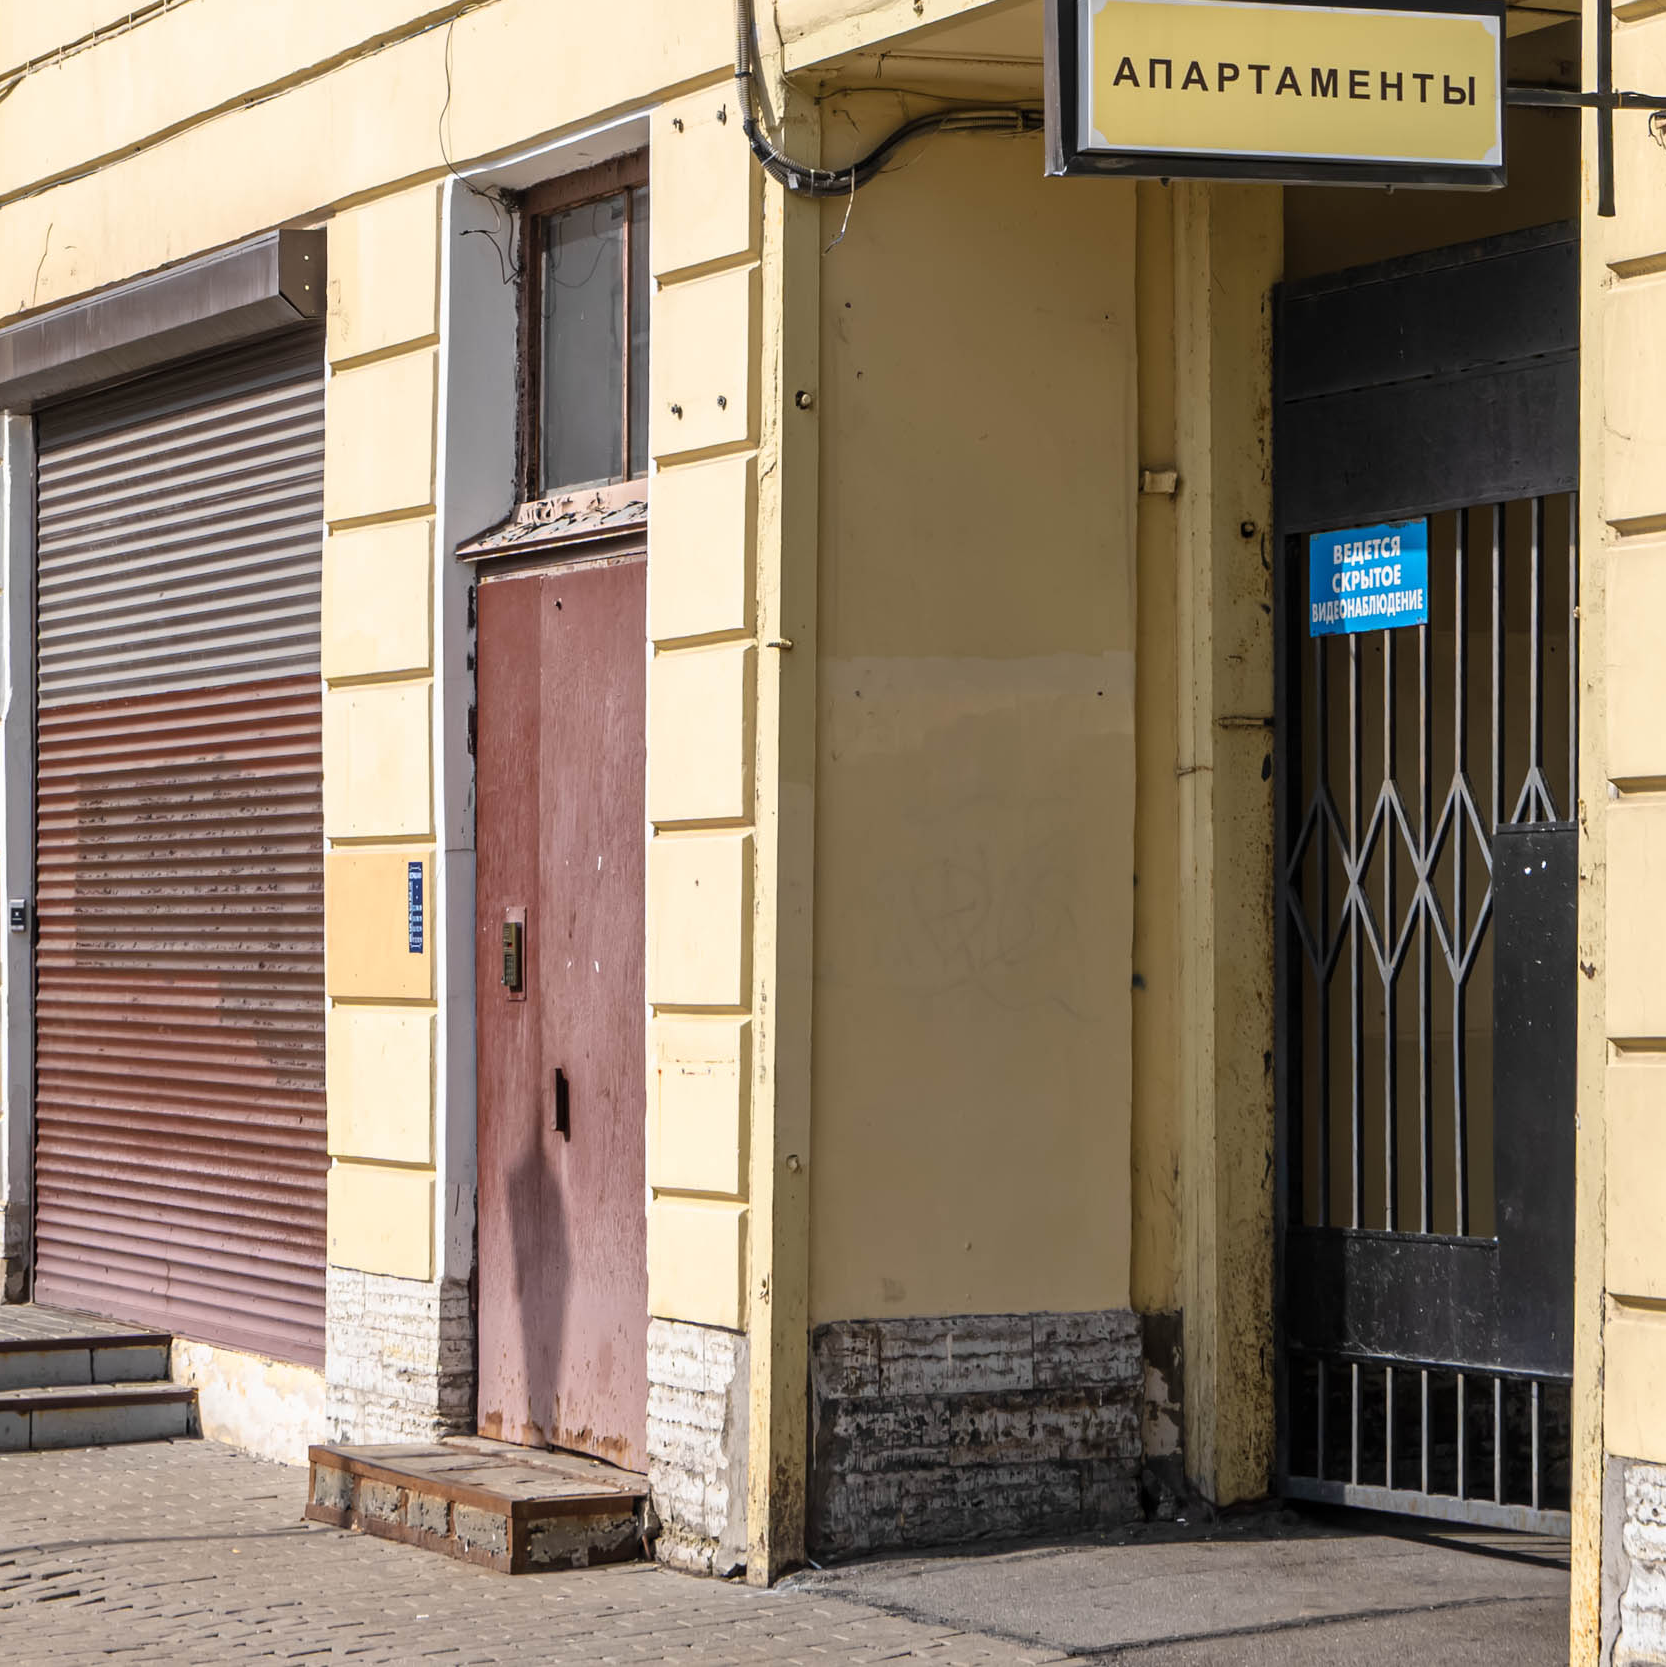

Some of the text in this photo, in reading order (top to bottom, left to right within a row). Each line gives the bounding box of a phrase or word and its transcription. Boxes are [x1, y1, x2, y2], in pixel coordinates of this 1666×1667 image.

[1112, 55, 1477, 106] АПАРТАМЕНТЫ
[1333, 536, 1401, 566] ВЕДЕТСЯ
[1332, 564, 1401, 593] СКРЫТОЕ
[1312, 588, 1423, 625] ВИДЕОНАБЛЮДЕНИЕ
